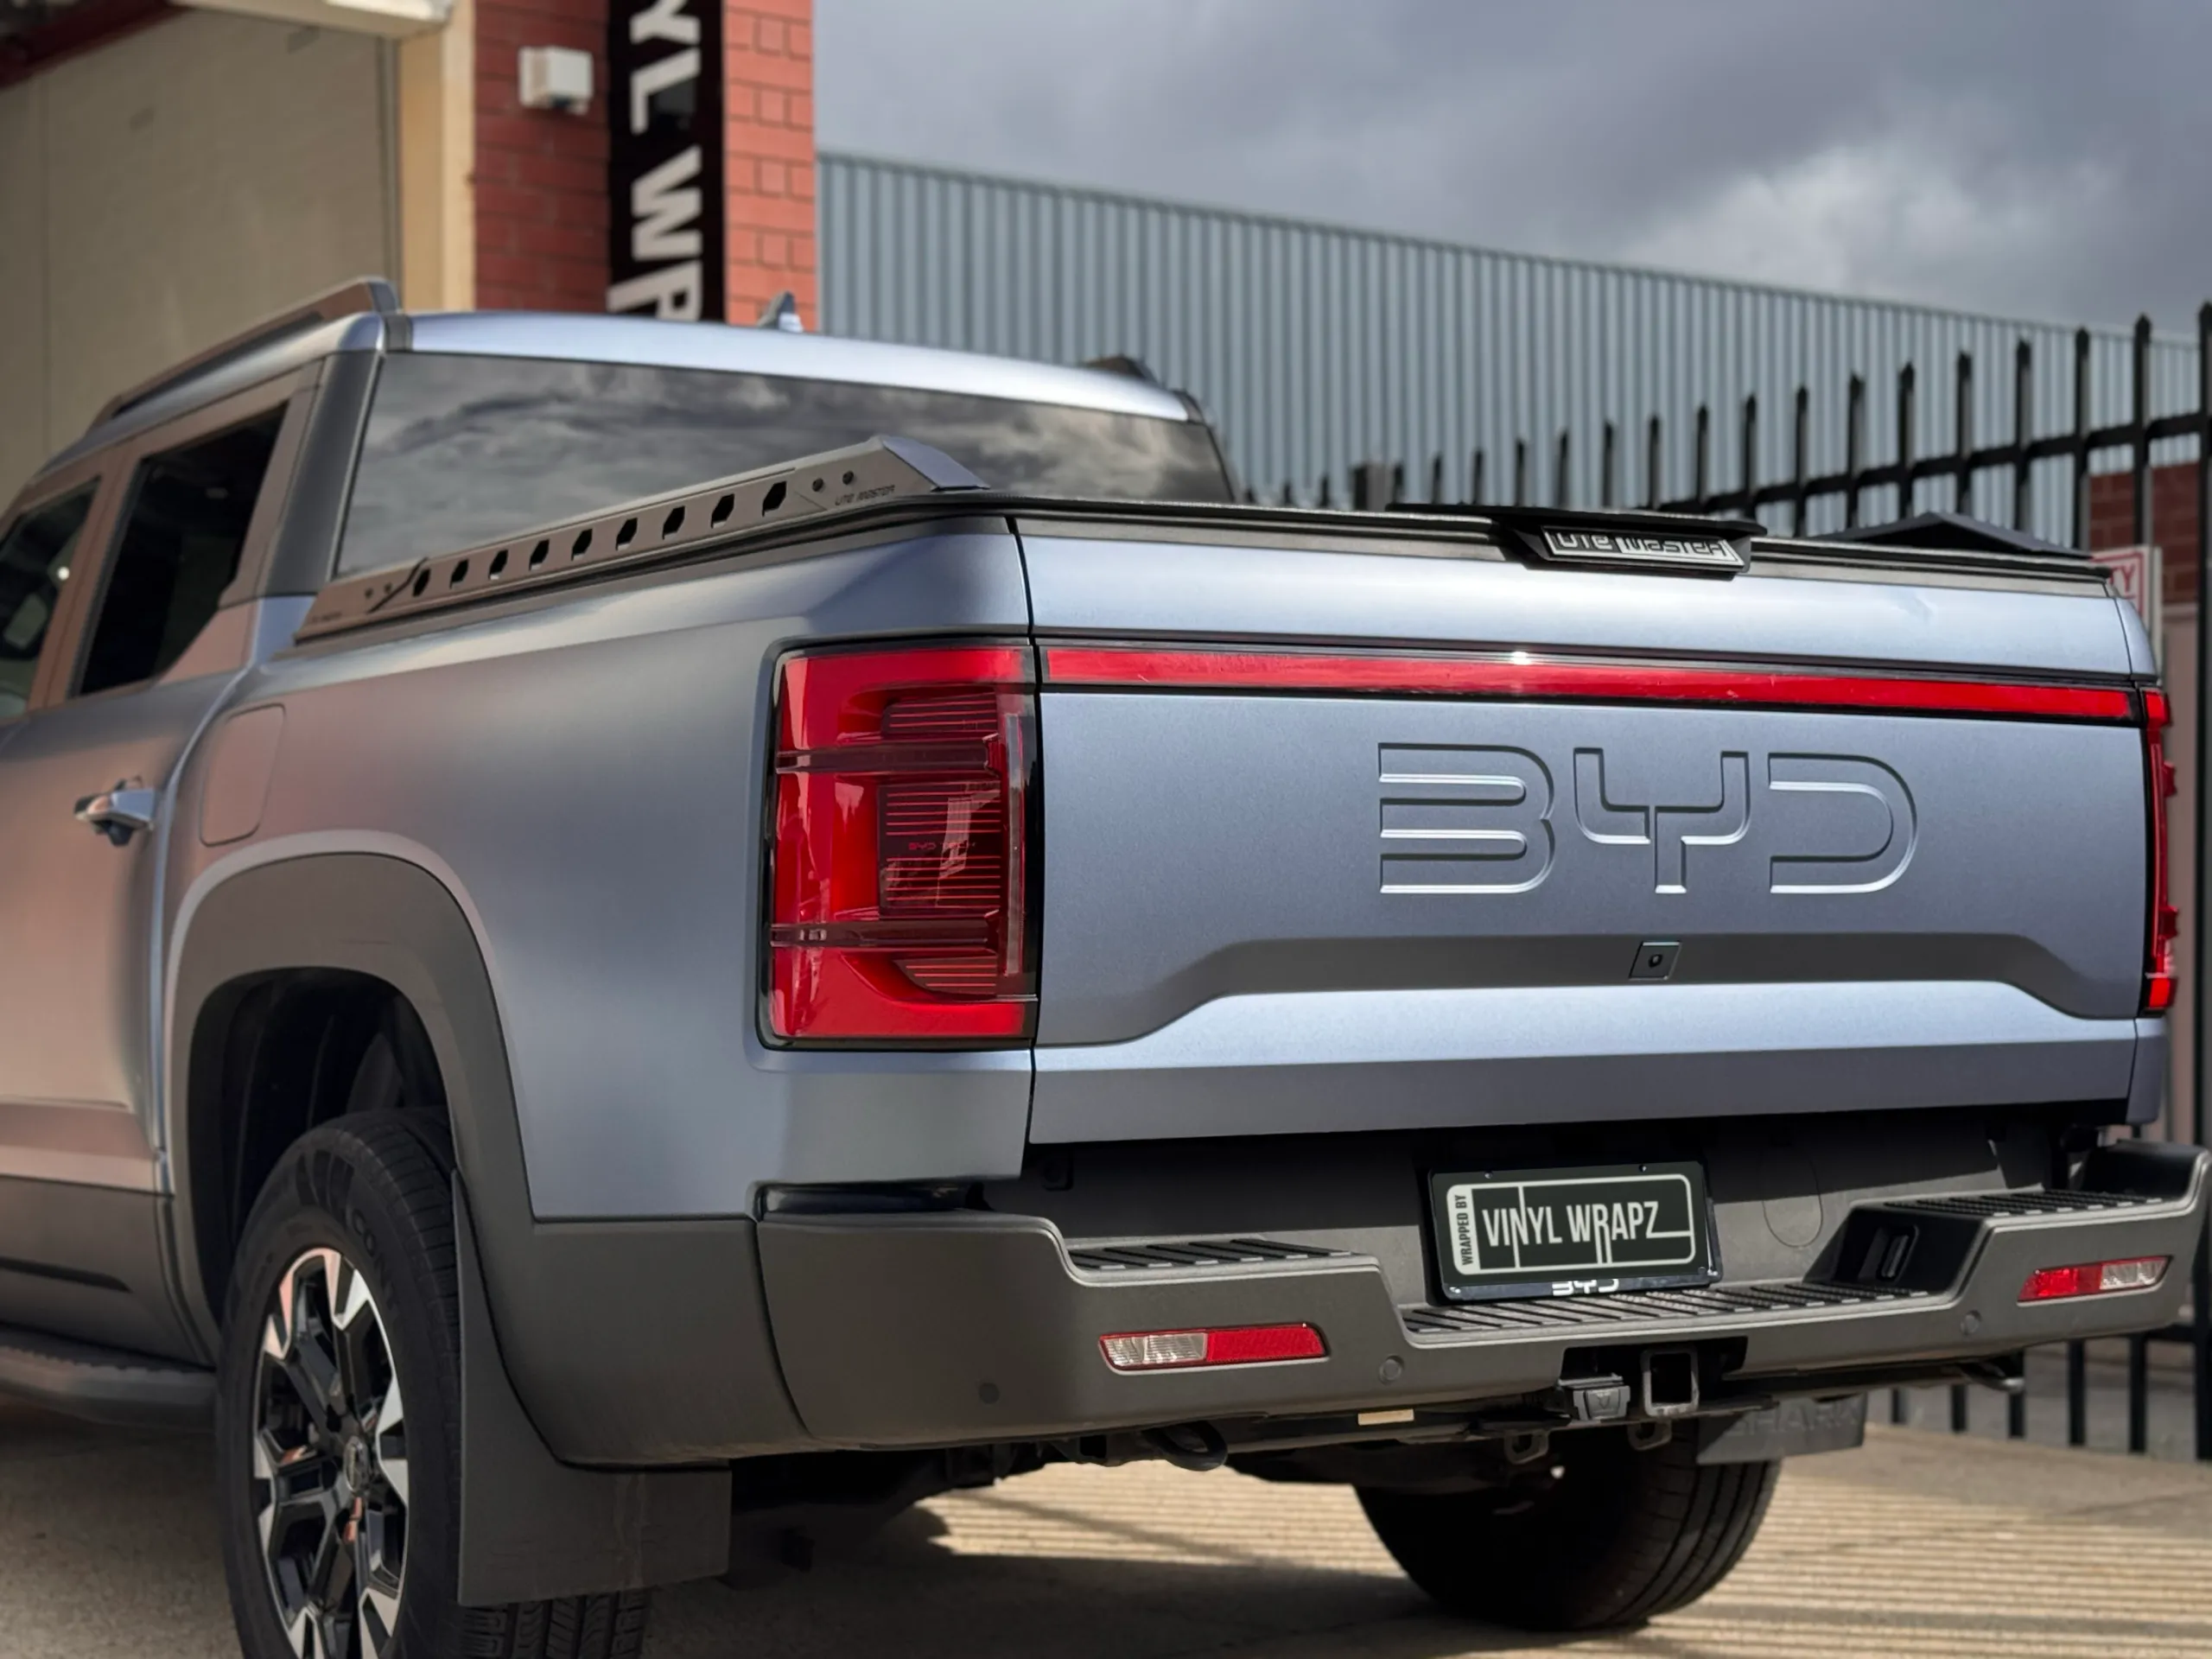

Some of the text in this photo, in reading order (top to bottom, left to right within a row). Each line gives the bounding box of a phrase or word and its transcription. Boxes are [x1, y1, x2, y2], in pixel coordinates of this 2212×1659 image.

[1378, 742, 1918, 893] BYD
[1454, 1193, 1474, 1267] WRAPPED BY
[1481, 1200, 1661, 1248] VINYL WRAPZ
